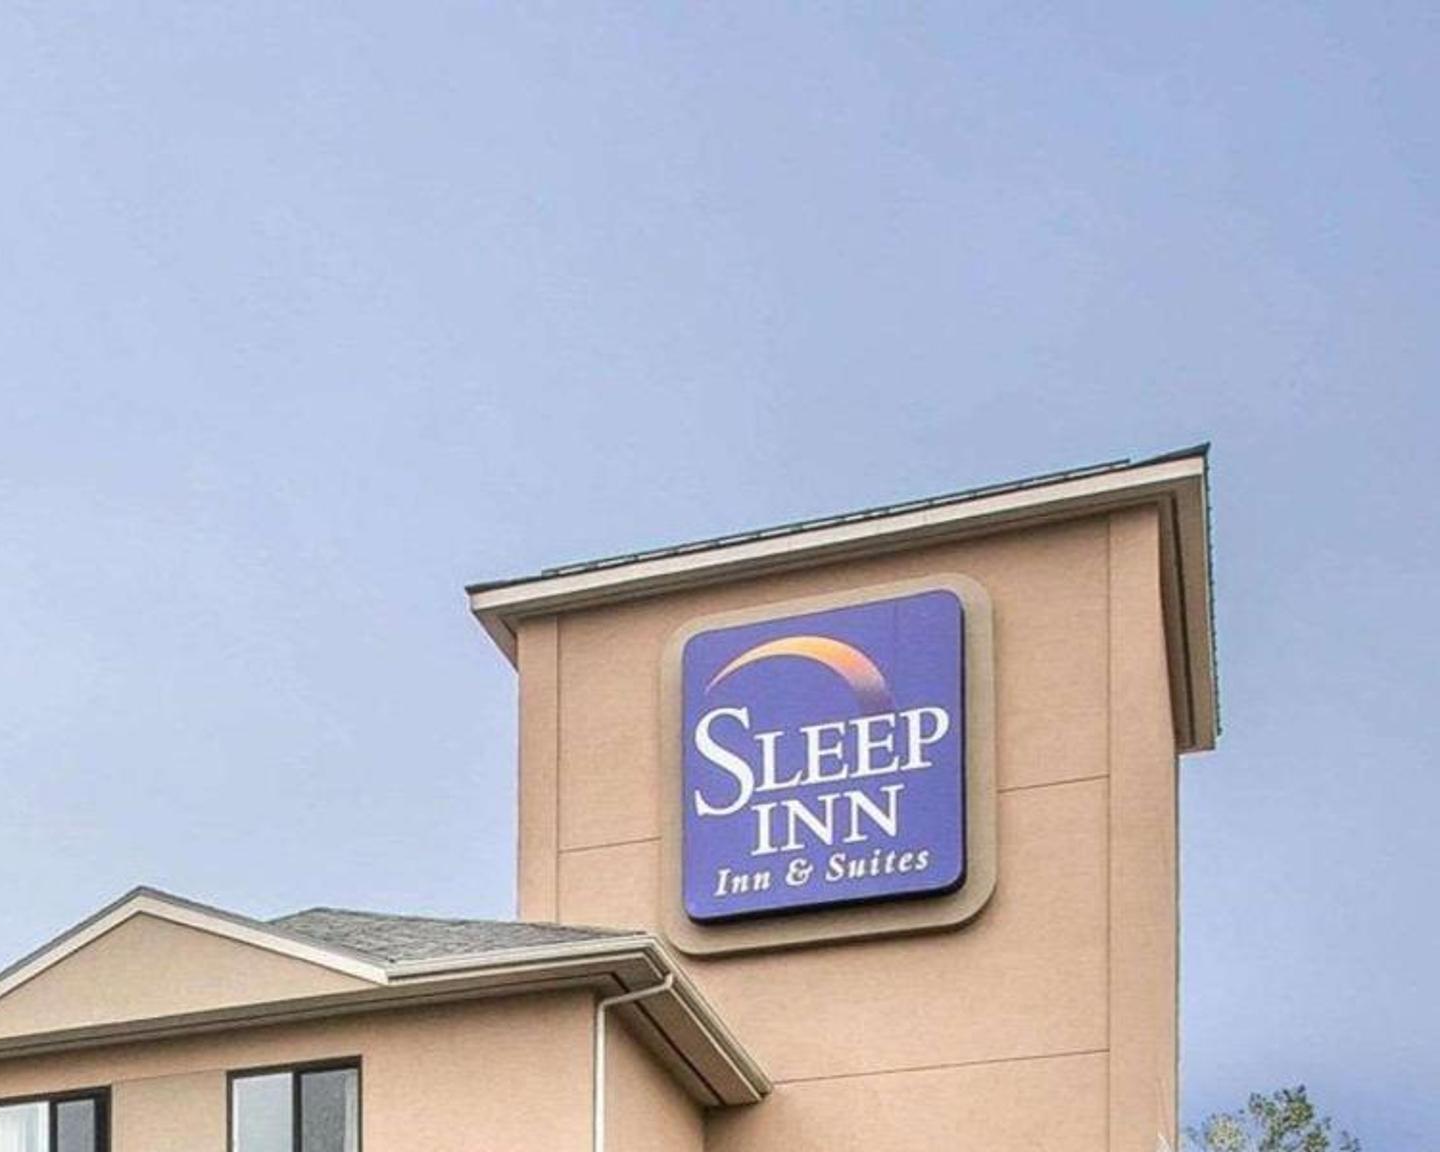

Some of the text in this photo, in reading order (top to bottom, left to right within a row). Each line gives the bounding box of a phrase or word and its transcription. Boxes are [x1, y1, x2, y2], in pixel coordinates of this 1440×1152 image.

[694, 706, 950, 816] SLEEP
[751, 784, 904, 856] INN
[714, 849, 930, 896] Inn & Suites
